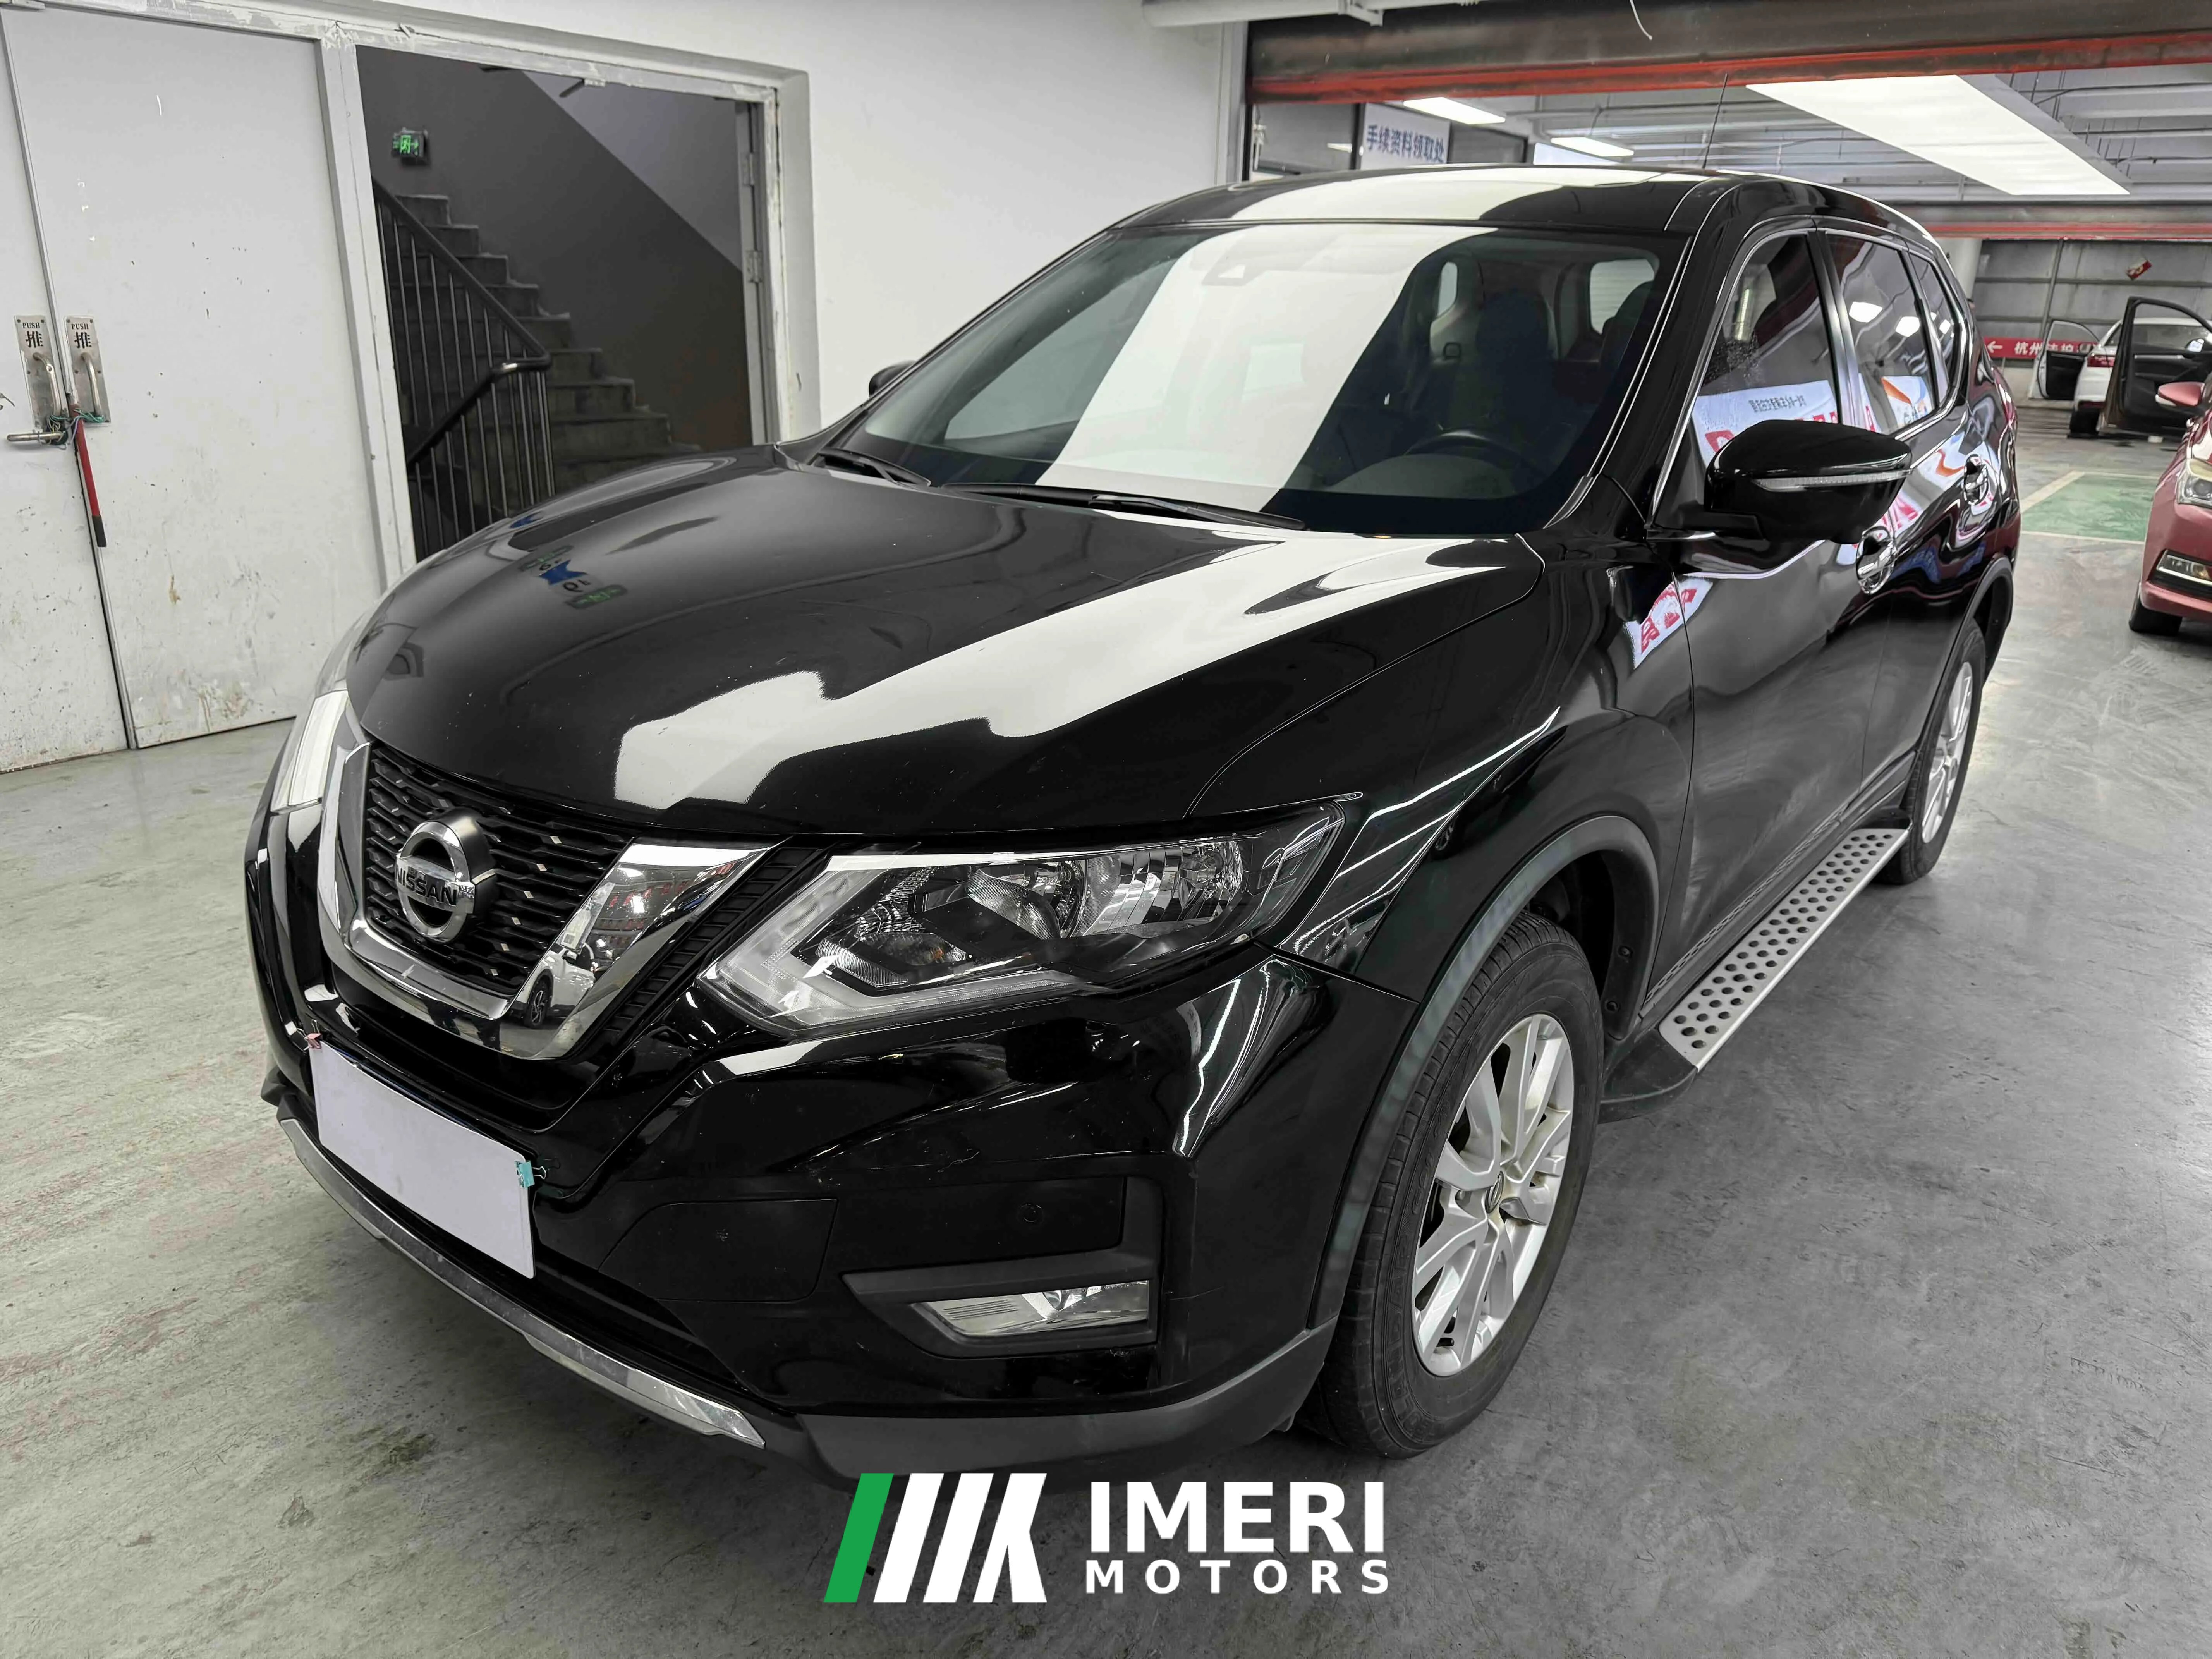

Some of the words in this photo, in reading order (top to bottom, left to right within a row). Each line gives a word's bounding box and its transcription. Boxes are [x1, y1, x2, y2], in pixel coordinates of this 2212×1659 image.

[1367, 124, 1444, 163] 手续资料领取处
[26, 331, 43, 348] 推
[74, 332, 92, 348] 推
[397, 866, 458, 907] NISSAN
